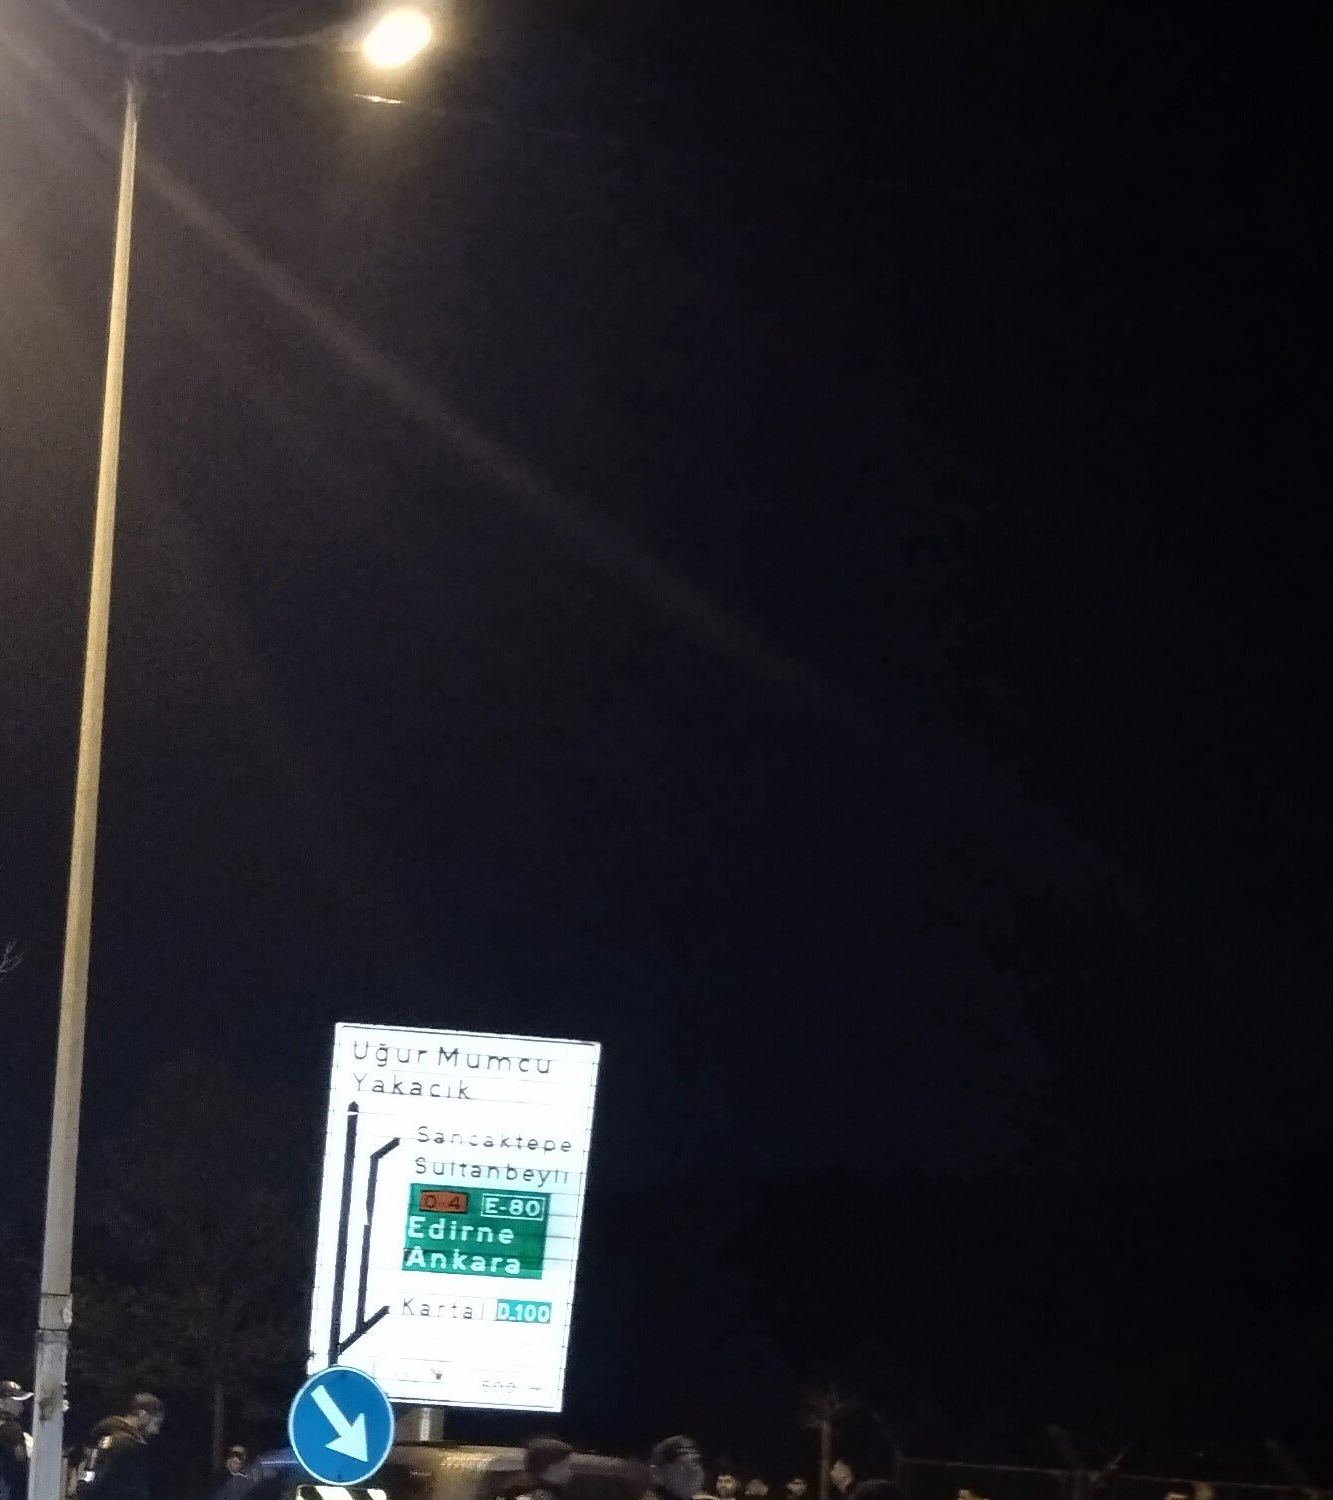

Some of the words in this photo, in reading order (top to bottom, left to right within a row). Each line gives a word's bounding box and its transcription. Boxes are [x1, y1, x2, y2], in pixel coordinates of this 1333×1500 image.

[354, 1040, 427, 1067] Uğur
[438, 1046, 551, 1074] Mumcu
[353, 1072, 470, 1099] Yakacık
[417, 1125, 572, 1153] Sancaktepe
[485, 1197, 541, 1217] E-80
[408, 1215, 515, 1244] Edirne
[406, 1246, 521, 1275] Ankara
[402, 1298, 485, 1320] Kartal
